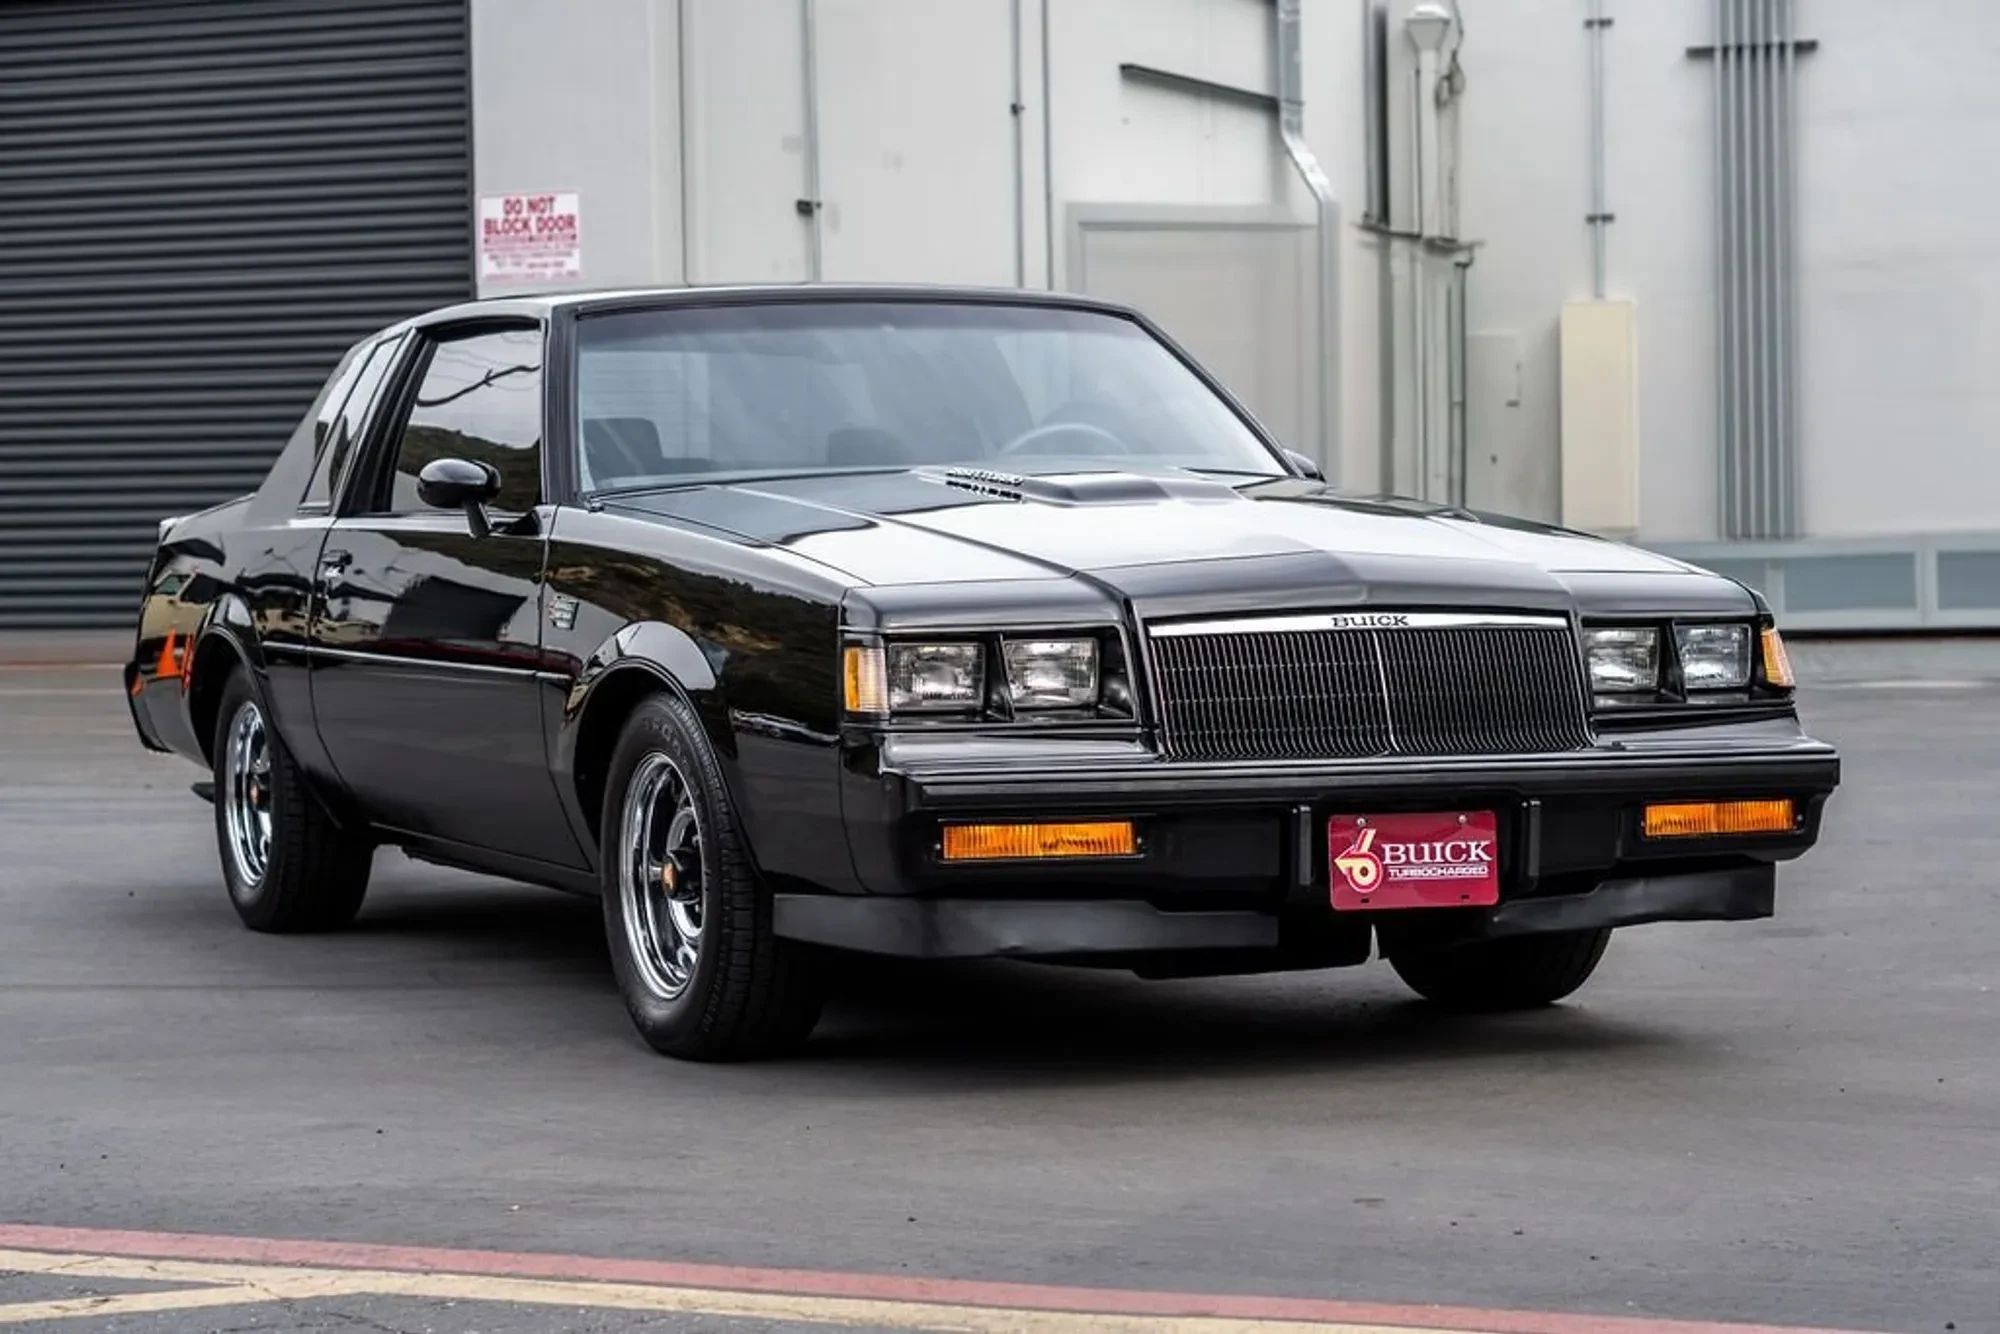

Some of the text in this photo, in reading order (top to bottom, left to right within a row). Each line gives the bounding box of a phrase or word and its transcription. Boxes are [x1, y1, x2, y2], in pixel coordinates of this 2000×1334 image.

[503, 196, 555, 215] DO NOT
[484, 214, 576, 235] BLOCK DOOR
[1331, 614, 1410, 628] BUICK
[1381, 840, 1493, 864] BUICK
[1388, 865, 1488, 878] TURBOCHARGED
